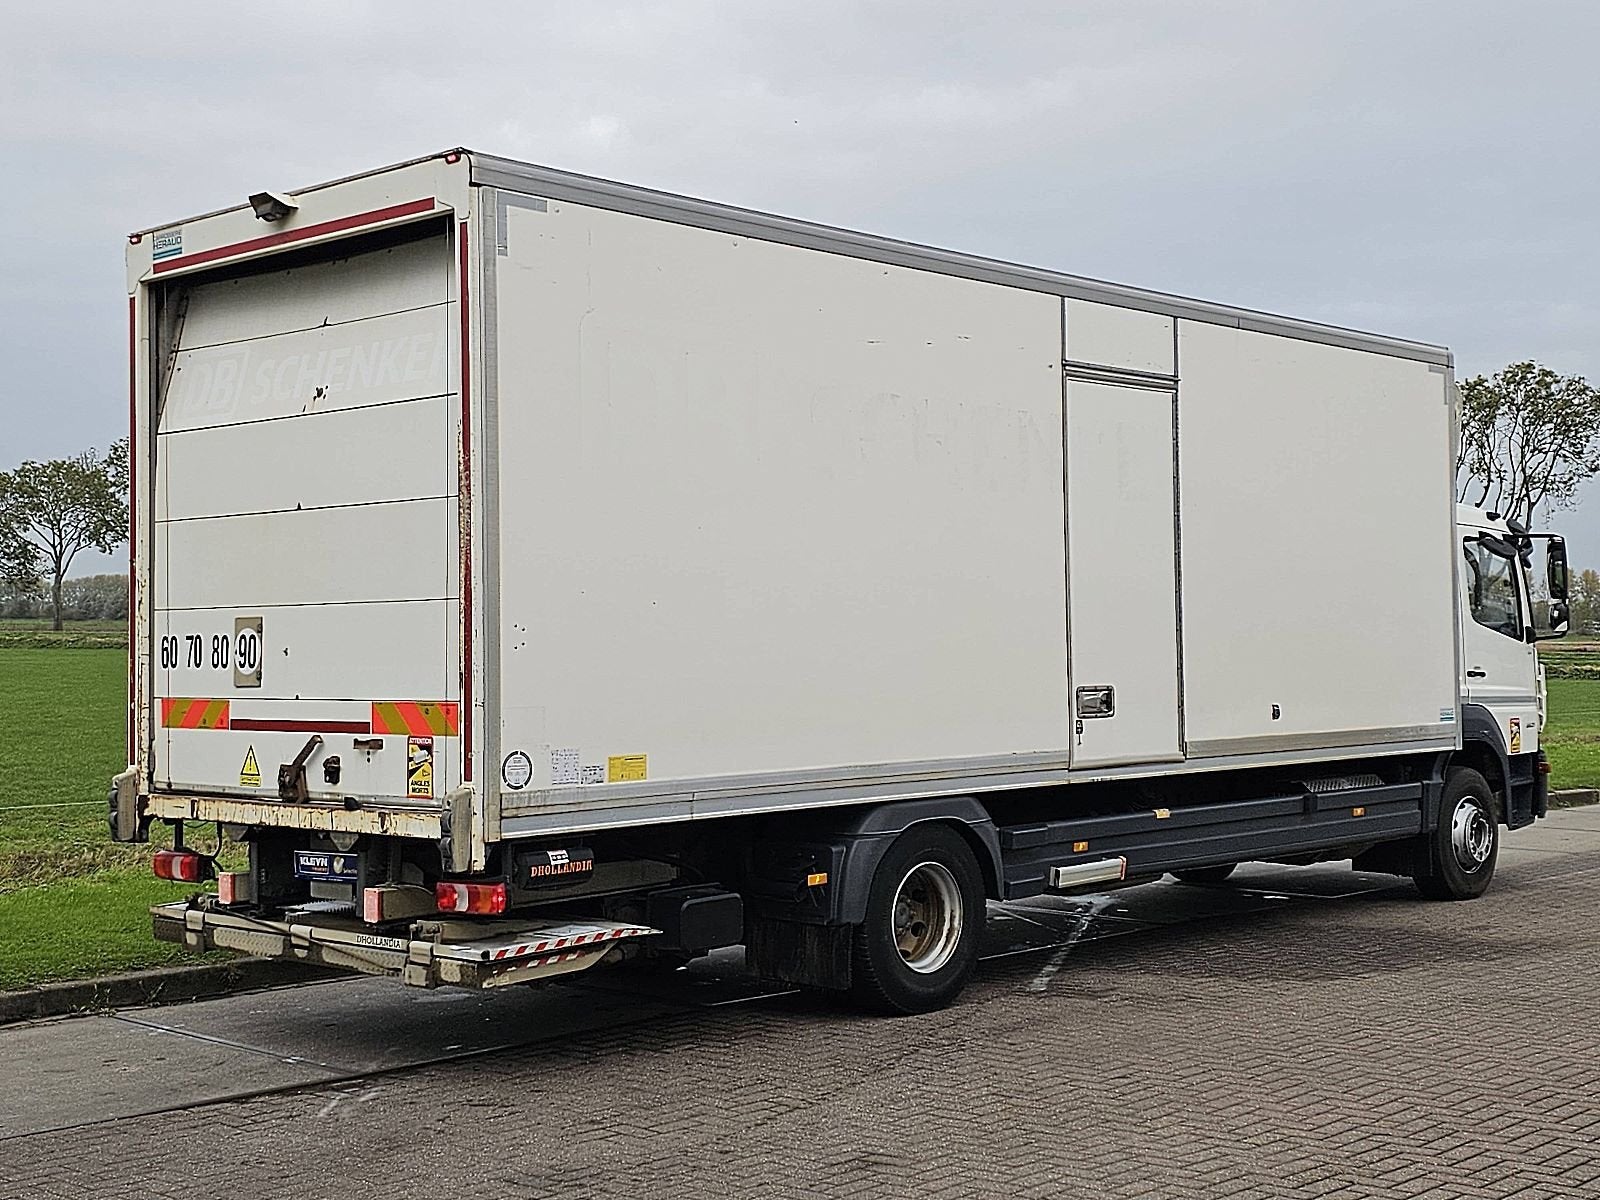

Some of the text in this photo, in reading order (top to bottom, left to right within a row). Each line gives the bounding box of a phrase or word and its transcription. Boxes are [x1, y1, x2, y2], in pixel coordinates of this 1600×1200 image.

[161, 634, 257, 669] 60 70 80 90
[299, 856, 328, 867] KLEYN
[530, 860, 593, 878] DHOLLANDIA
[356, 935, 401, 949] DHOLLANDIA
